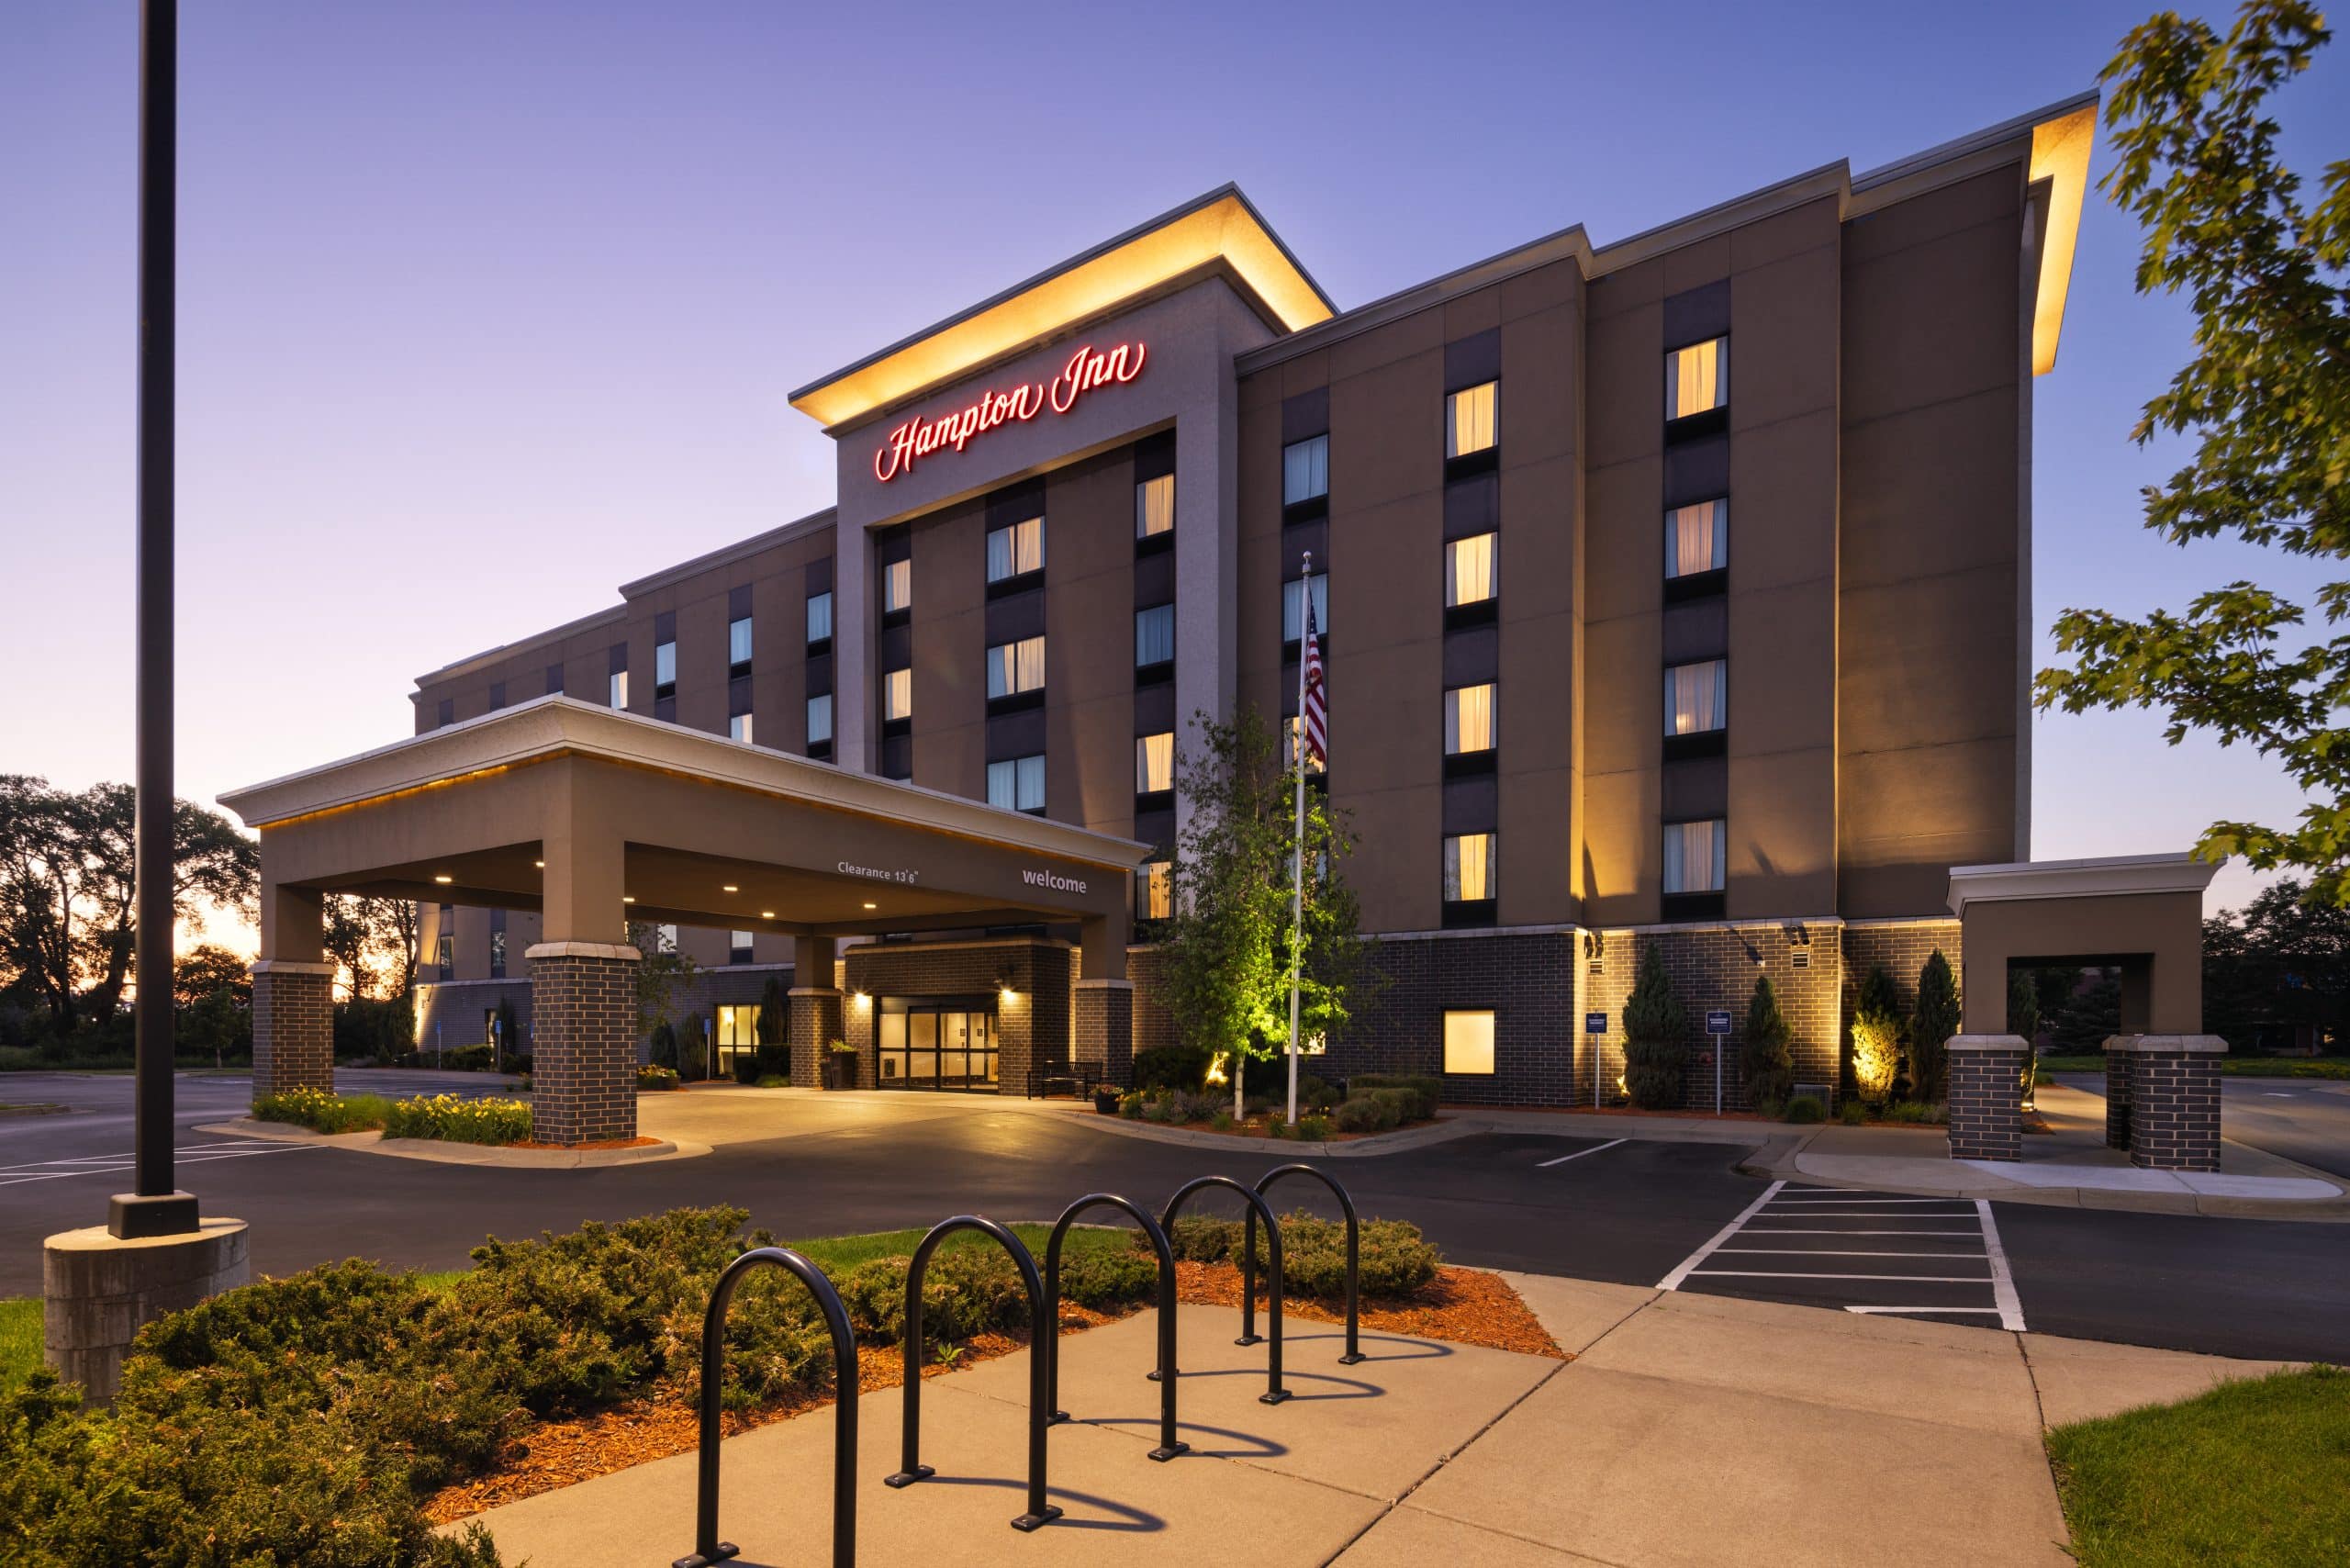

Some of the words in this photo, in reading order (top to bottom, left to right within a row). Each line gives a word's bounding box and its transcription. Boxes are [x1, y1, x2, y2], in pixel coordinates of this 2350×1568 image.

[875, 382, 1045, 483] Hampton
[1051, 342, 1147, 414] Inn
[837, 861, 890, 879] Clearance
[1022, 869, 1087, 894] welcome
